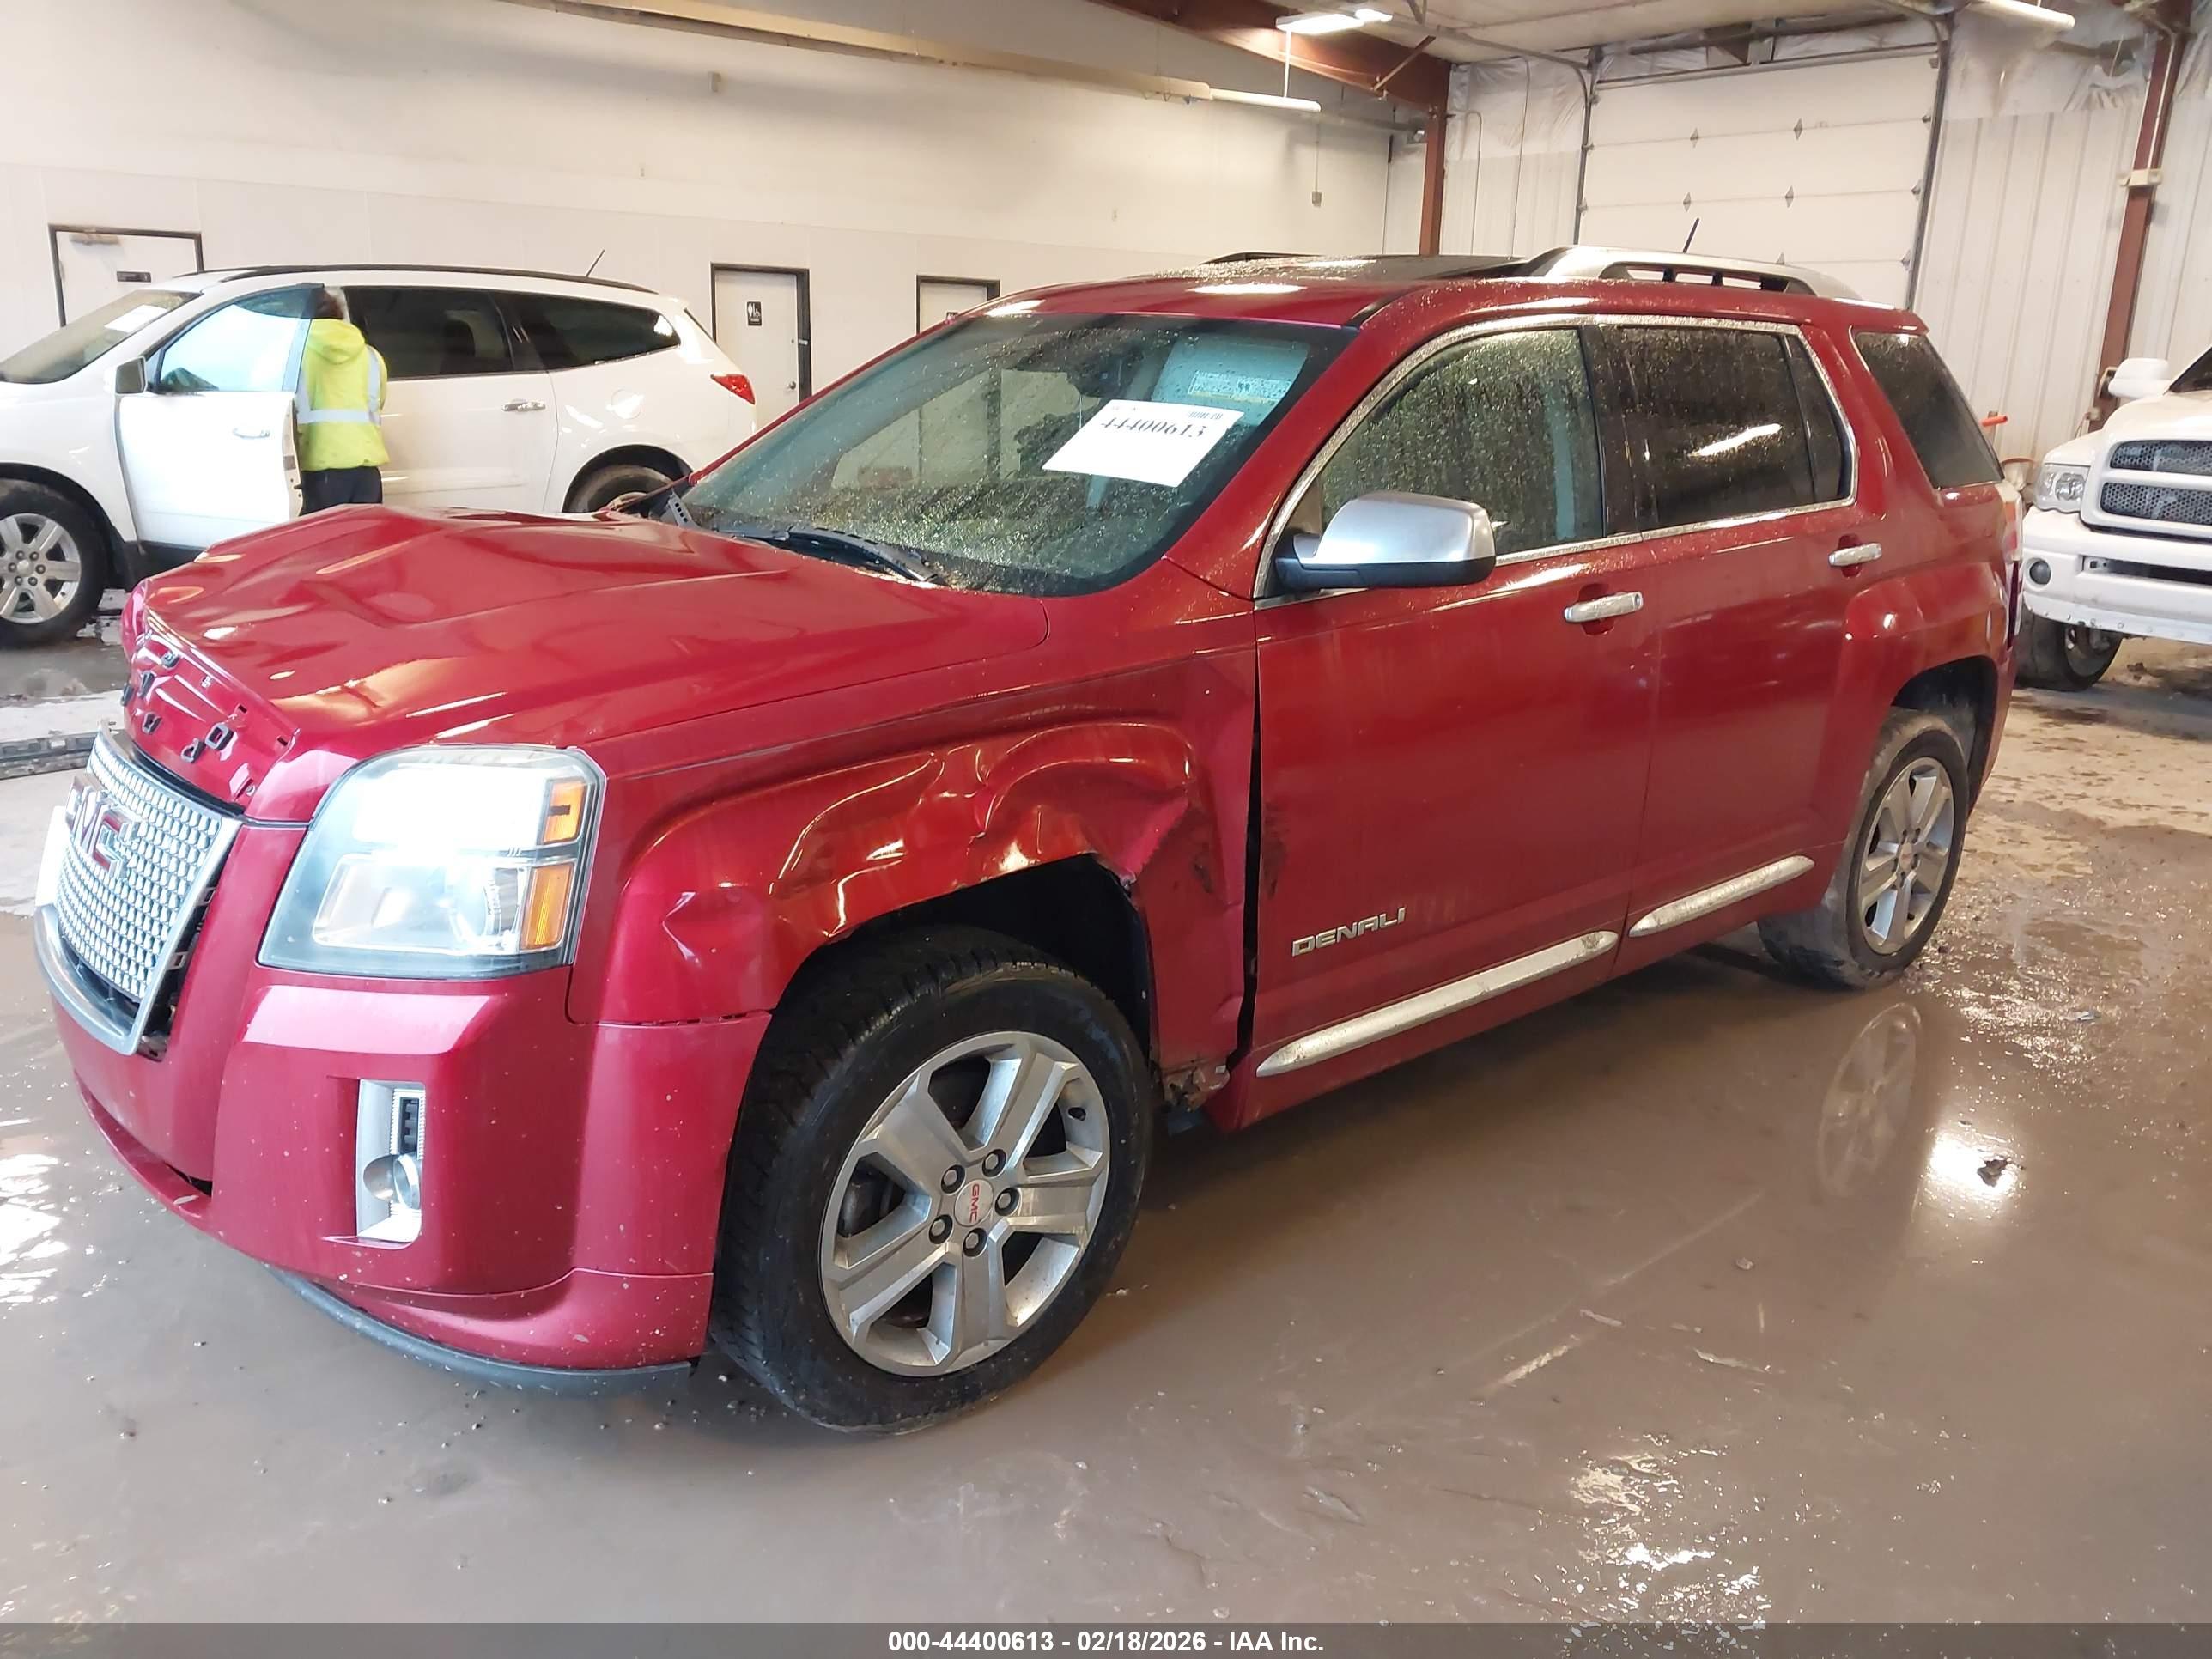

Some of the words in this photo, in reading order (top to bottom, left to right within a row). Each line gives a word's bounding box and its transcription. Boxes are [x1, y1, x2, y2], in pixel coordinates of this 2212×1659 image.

[1101, 417, 1206, 437] 44400613
[65, 776, 134, 879] MC
[1291, 907, 1406, 957] DENALI
[969, 1183, 979, 1223] GMC
